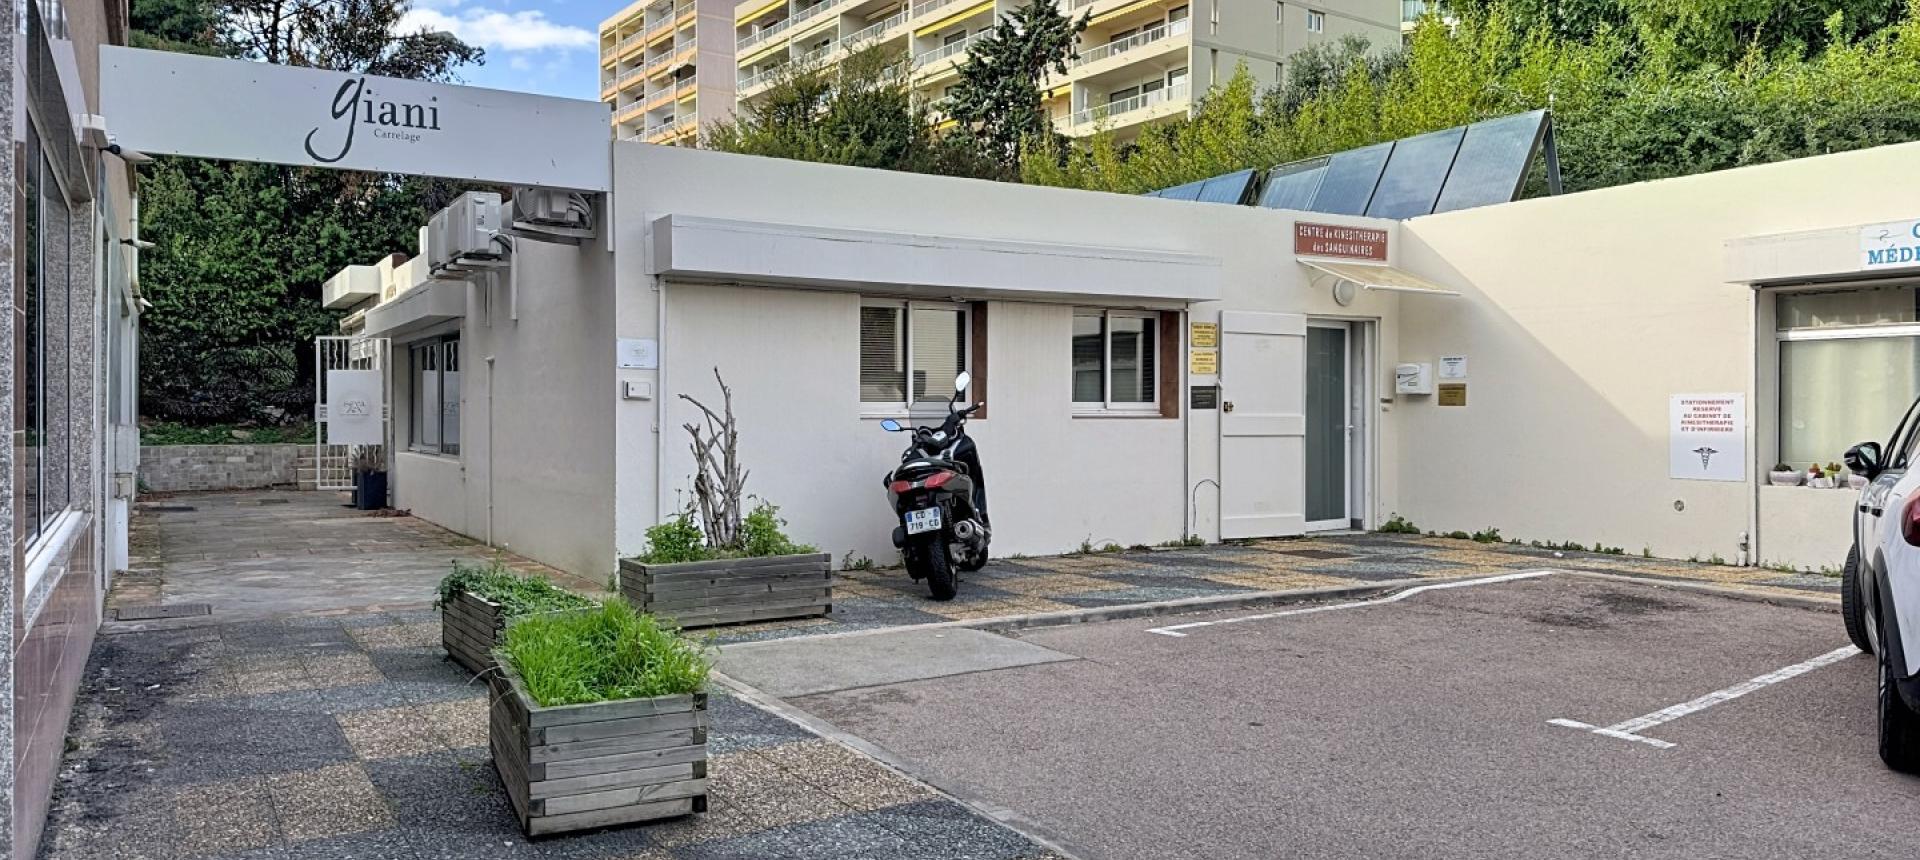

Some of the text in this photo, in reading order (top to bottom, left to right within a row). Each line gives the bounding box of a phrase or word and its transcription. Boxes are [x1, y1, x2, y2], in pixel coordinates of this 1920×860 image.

[304, 78, 441, 163] giani
[374, 129, 421, 143] Carrelage
[1299, 225, 1324, 238] CENTRE
[1334, 229, 1385, 243] KINESITHERAPIE
[1312, 241, 1373, 256] des SANGUINAIRES
